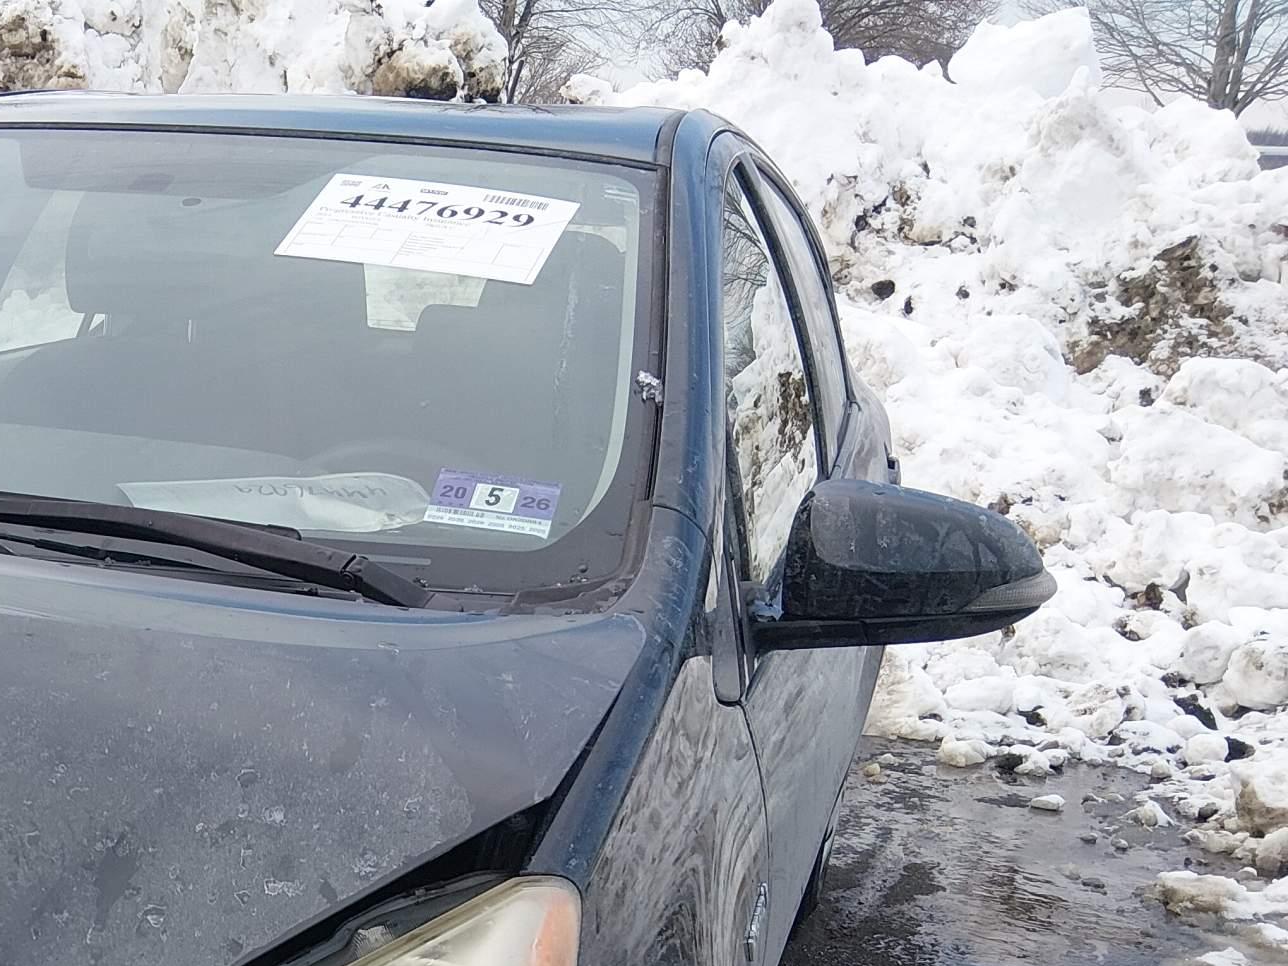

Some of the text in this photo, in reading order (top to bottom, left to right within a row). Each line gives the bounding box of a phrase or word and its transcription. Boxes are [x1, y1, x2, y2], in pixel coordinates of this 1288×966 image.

[340, 193, 535, 228] 44476929
[439, 485, 552, 511] 20 5 26
